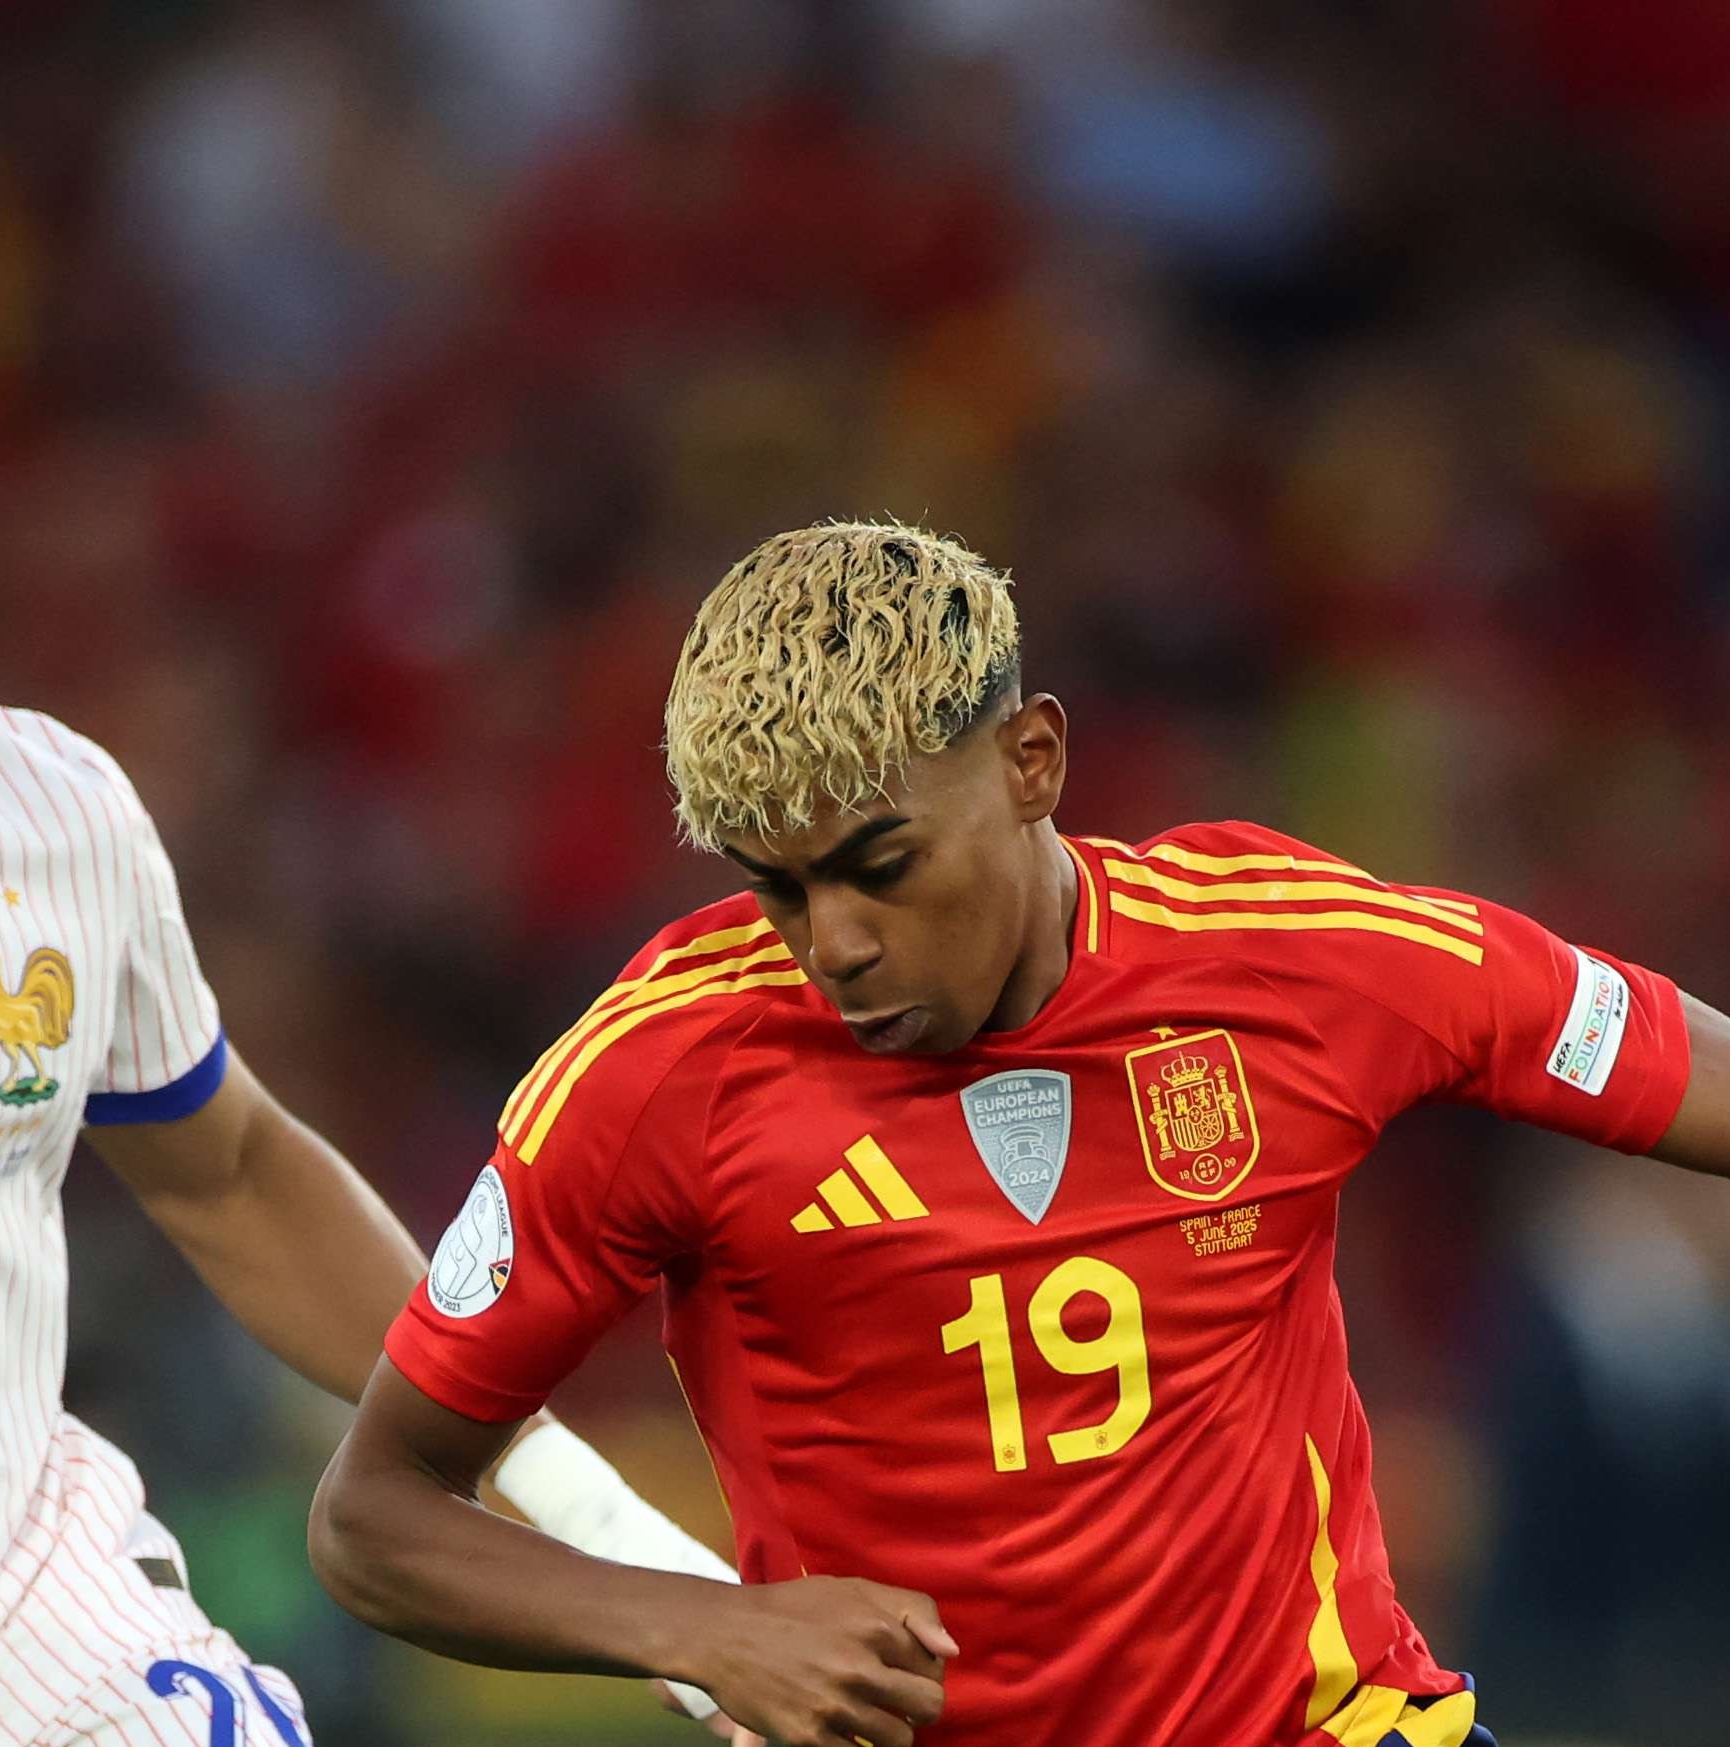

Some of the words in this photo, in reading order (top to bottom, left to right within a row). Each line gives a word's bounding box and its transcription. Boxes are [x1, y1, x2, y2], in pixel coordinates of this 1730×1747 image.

[1552, 1040, 1572, 1073] UEFA
[997, 1078, 1033, 1094] UEFA
[973, 1088, 1060, 1114] EUROPEAN
[976, 1103, 1062, 1128] CHAMPIONS
[1008, 1169, 1051, 1188] 2024
[1179, 1215, 1212, 1233] SPAIN
[1221, 1203, 1262, 1225] FRANCE
[1185, 1231, 1196, 1245] 5
[1199, 1224, 1227, 1243] JUNE
[1229, 1218, 1258, 1236] 2025
[1194, 1232, 1254, 1257] STUTTGART
[941, 1256, 1153, 1473] 19
